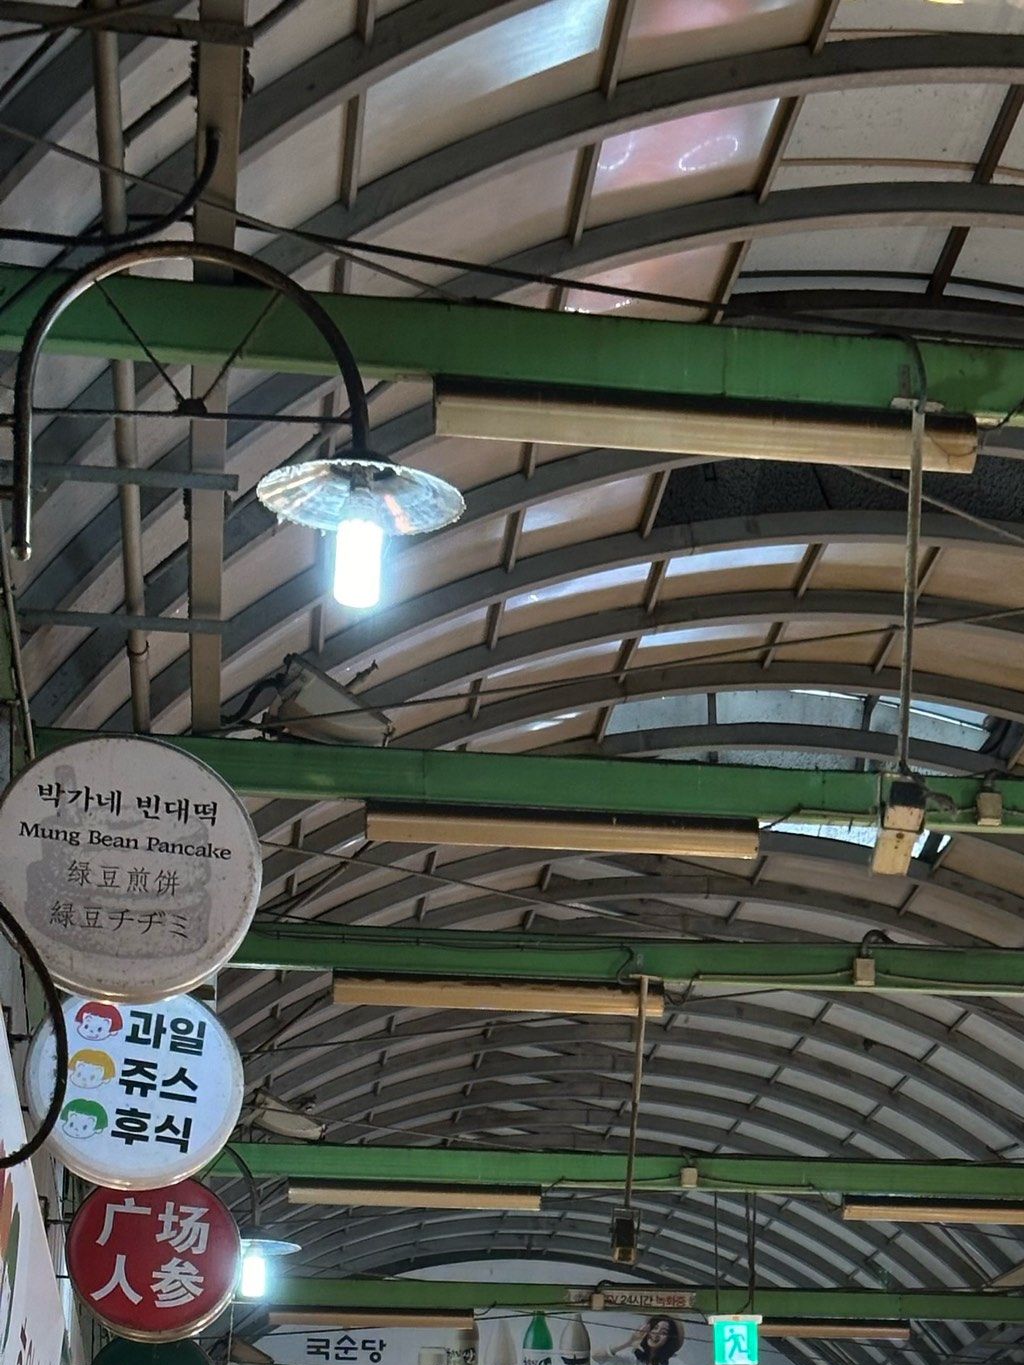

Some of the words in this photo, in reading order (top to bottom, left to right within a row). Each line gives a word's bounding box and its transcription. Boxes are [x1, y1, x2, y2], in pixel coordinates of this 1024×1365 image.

[37, 782, 122, 817] 박가네
[136, 794, 218, 827] 빈대떡
[19, 821, 80, 846] Mung
[88, 830, 138, 851] Bean
[146, 837, 232, 861] Pancake
[67, 859, 180, 897] 绿豆煎饼
[125, 1010, 207, 1056] 과일
[118, 1058, 198, 1104] 쥬스
[111, 1107, 192, 1154] 후식
[96, 1197, 210, 1255] 广场
[90, 1254, 204, 1308] 人参
[306, 1335, 387, 1363] 국순당
